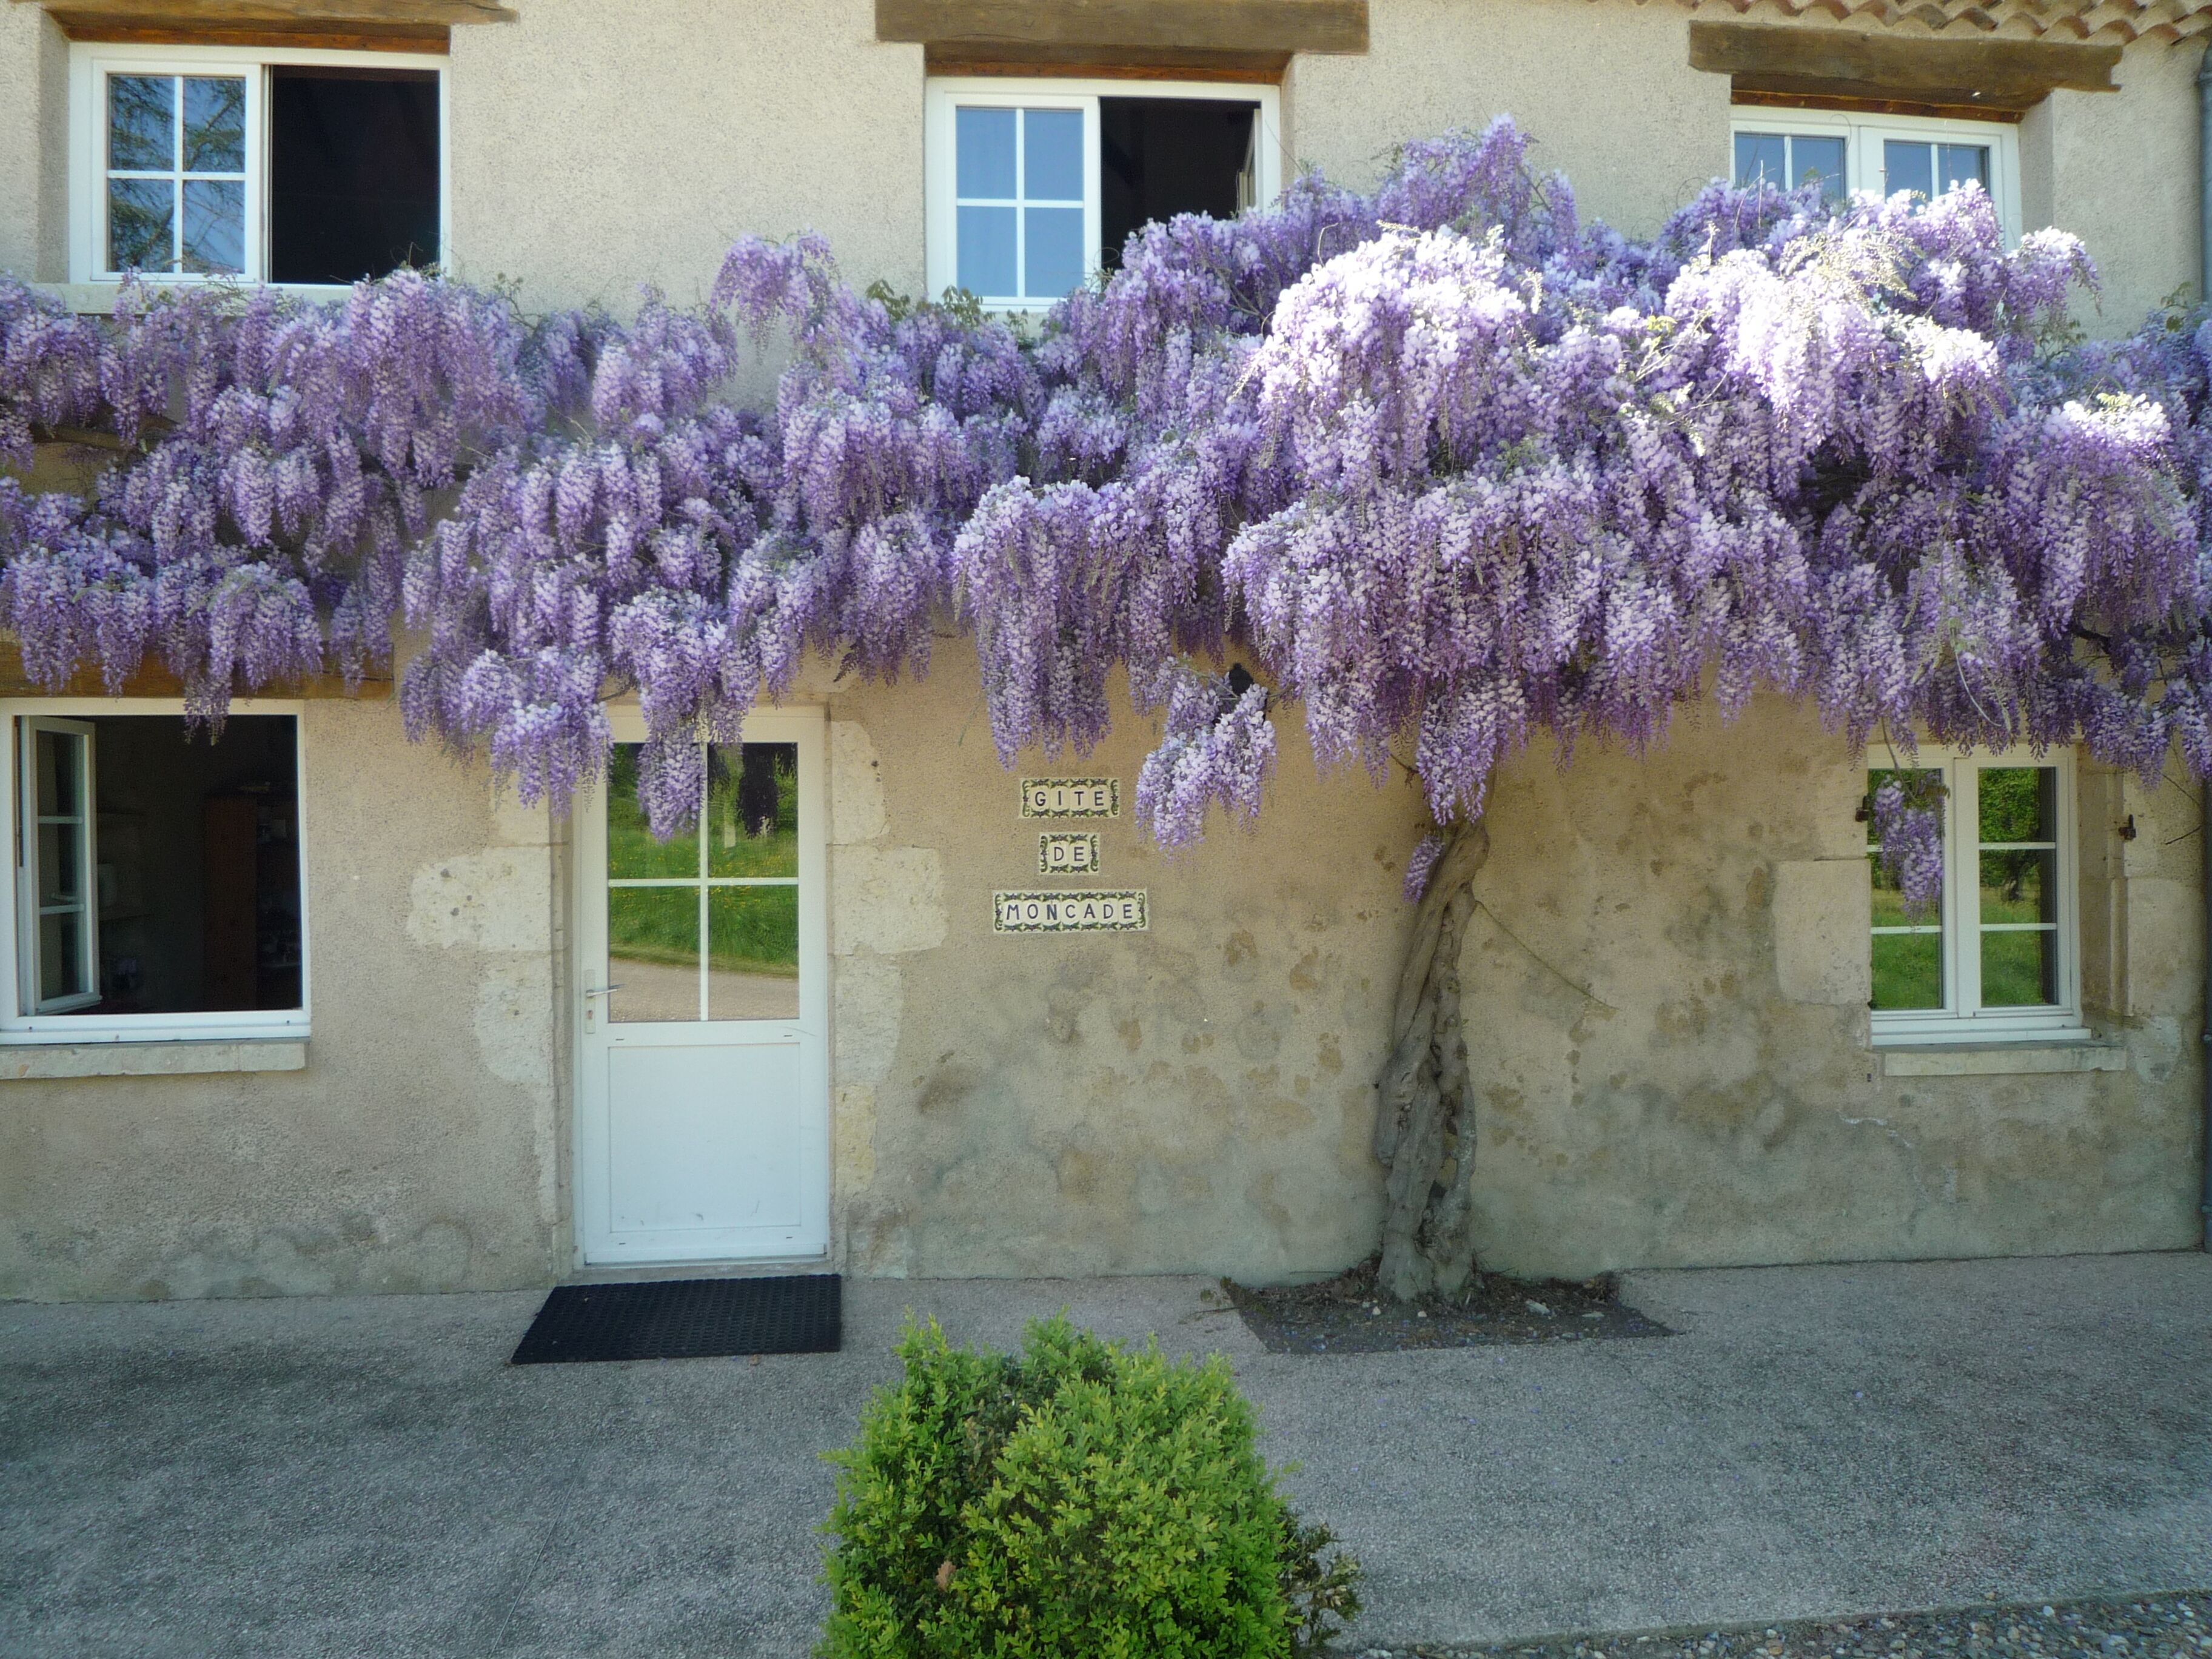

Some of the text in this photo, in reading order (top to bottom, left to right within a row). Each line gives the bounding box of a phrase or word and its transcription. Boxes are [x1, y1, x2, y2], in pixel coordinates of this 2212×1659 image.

[1034, 790, 1104, 806] GITE
[1054, 846, 1084, 862] DE
[1006, 903, 1133, 920] MONCADE
